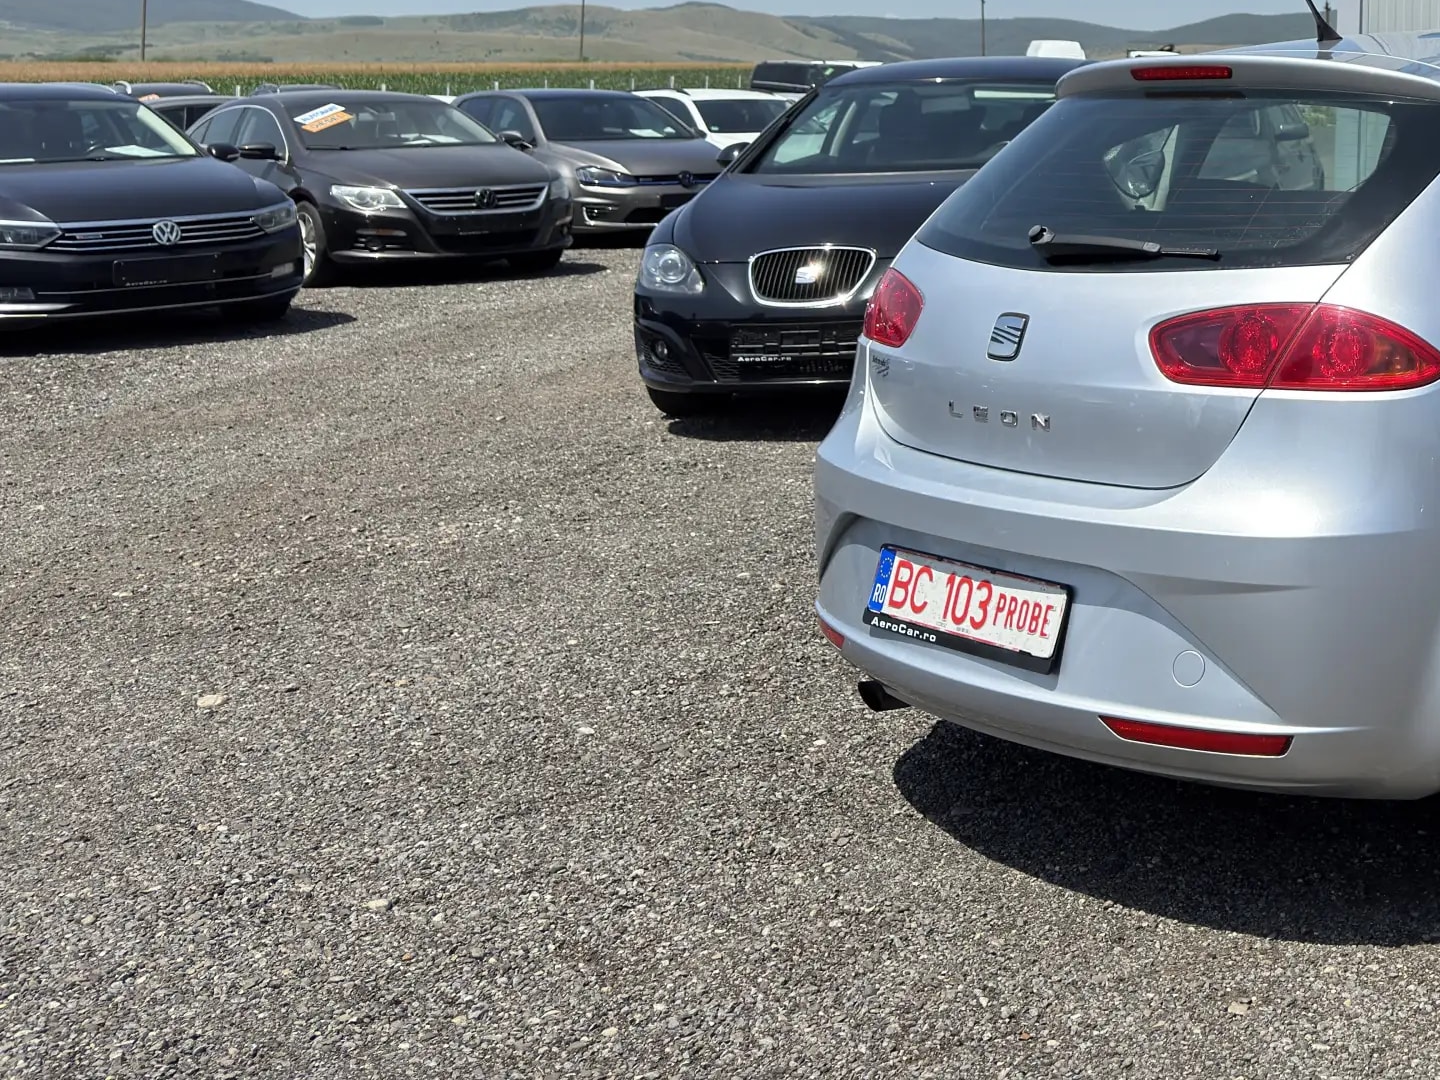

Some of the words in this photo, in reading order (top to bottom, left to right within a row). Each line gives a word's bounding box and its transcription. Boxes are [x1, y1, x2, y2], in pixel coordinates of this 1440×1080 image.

[948, 399, 1051, 432] LEON
[874, 583, 887, 605] RO
[888, 560, 934, 614] BC
[943, 572, 993, 630] 103
[993, 593, 1055, 638] PROBE
[870, 616, 937, 644] AeroCar.ro
